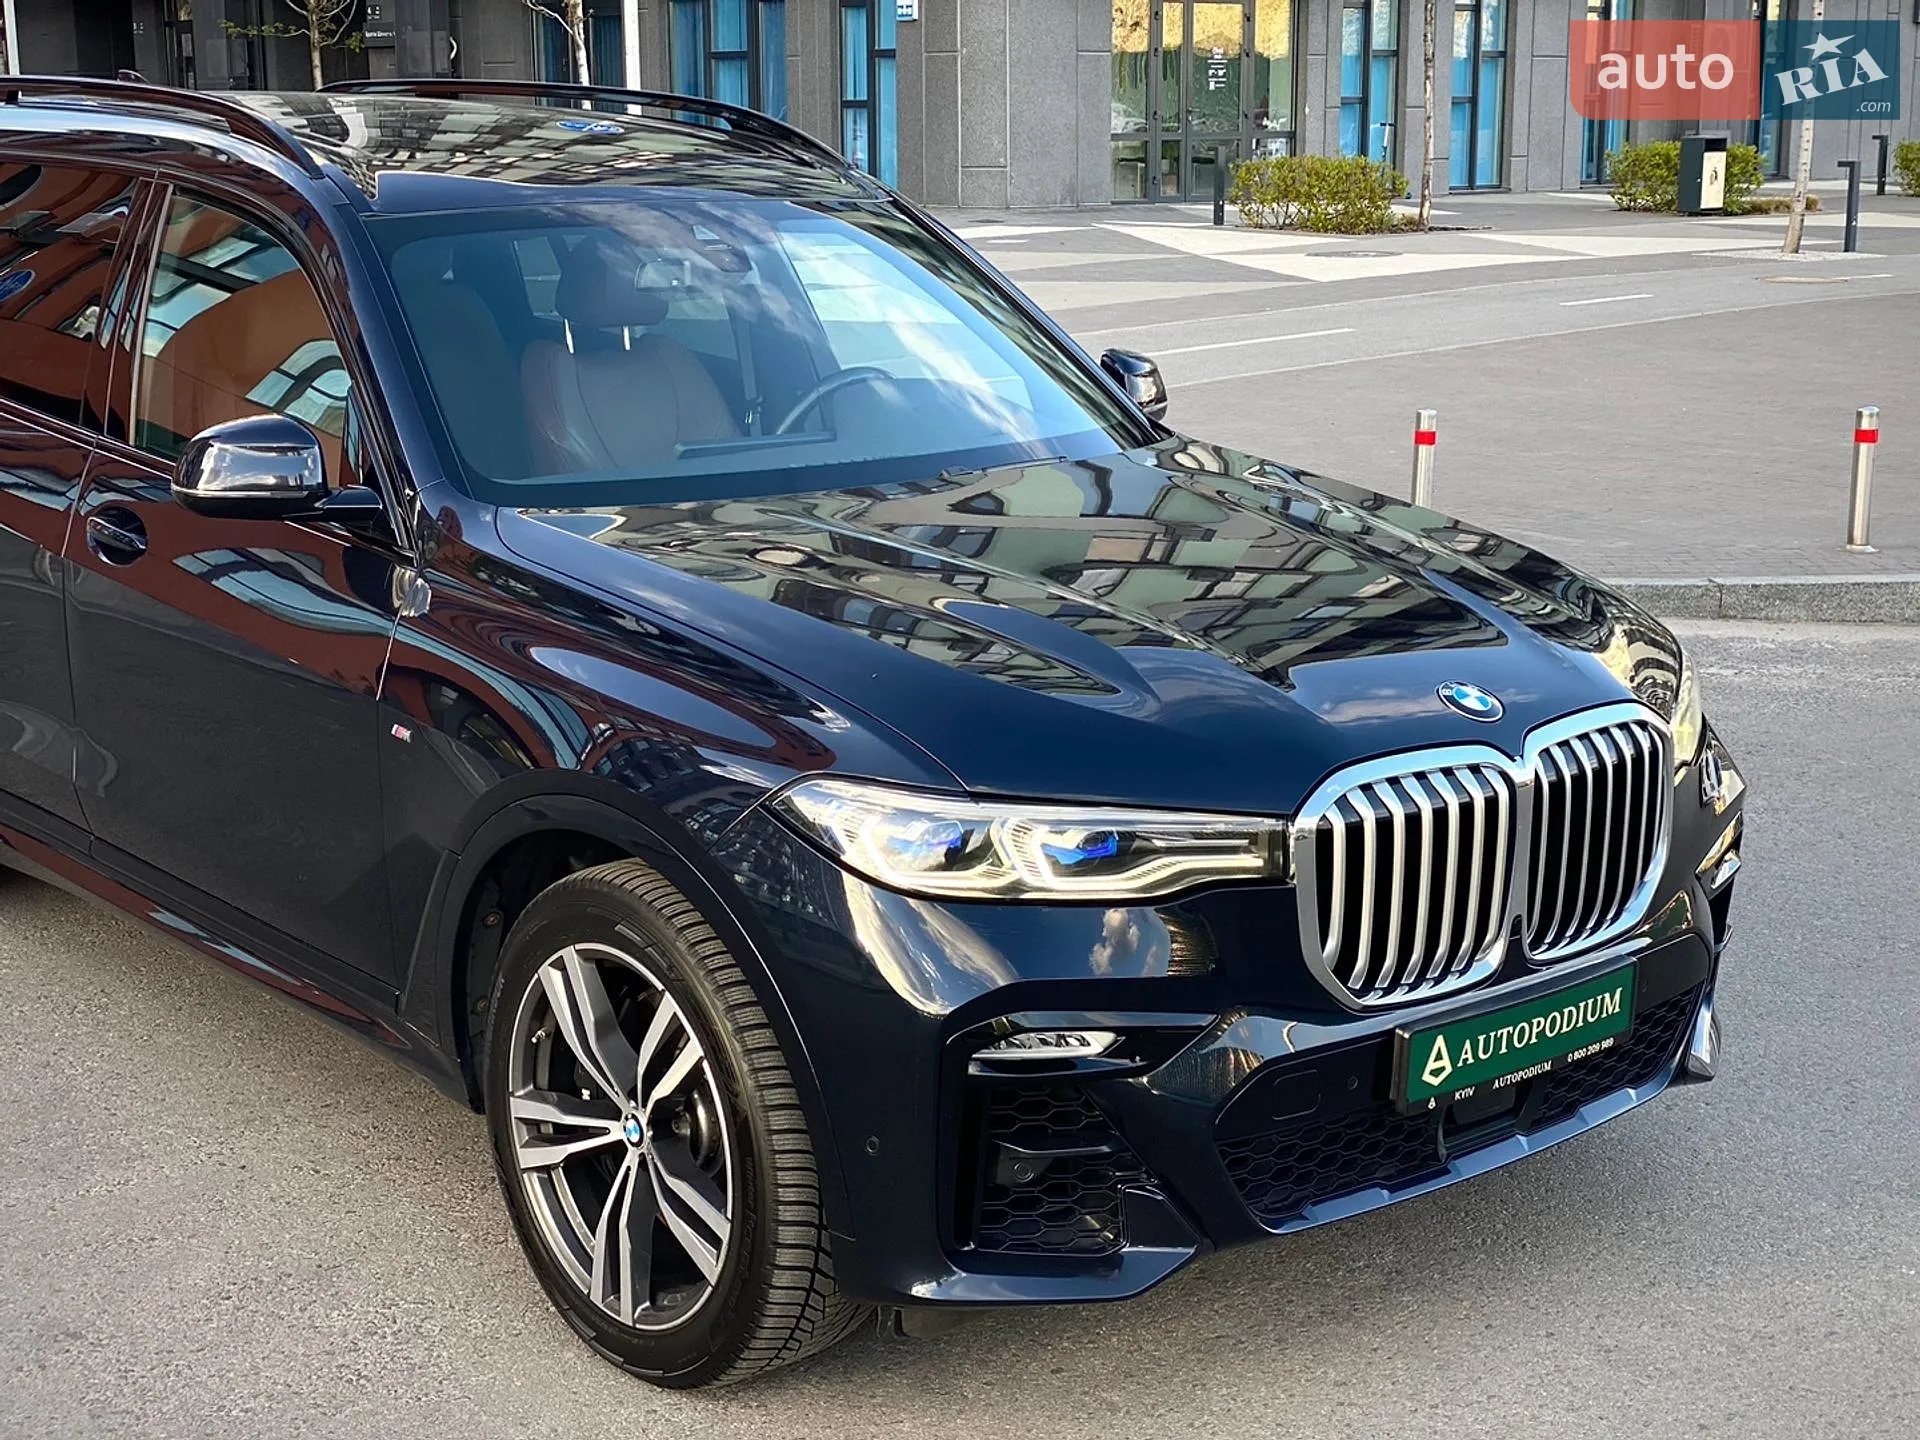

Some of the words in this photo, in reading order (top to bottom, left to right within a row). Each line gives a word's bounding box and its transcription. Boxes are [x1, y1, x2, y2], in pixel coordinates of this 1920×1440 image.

[1456, 987, 1622, 1067] AUTOPODIUM
[1454, 1086, 1476, 1101] KYIV
[1493, 1060, 1552, 1089] AUTOPODIUM
[1567, 1052, 1574, 1063] 0
[1573, 1047, 1587, 1060] 800
